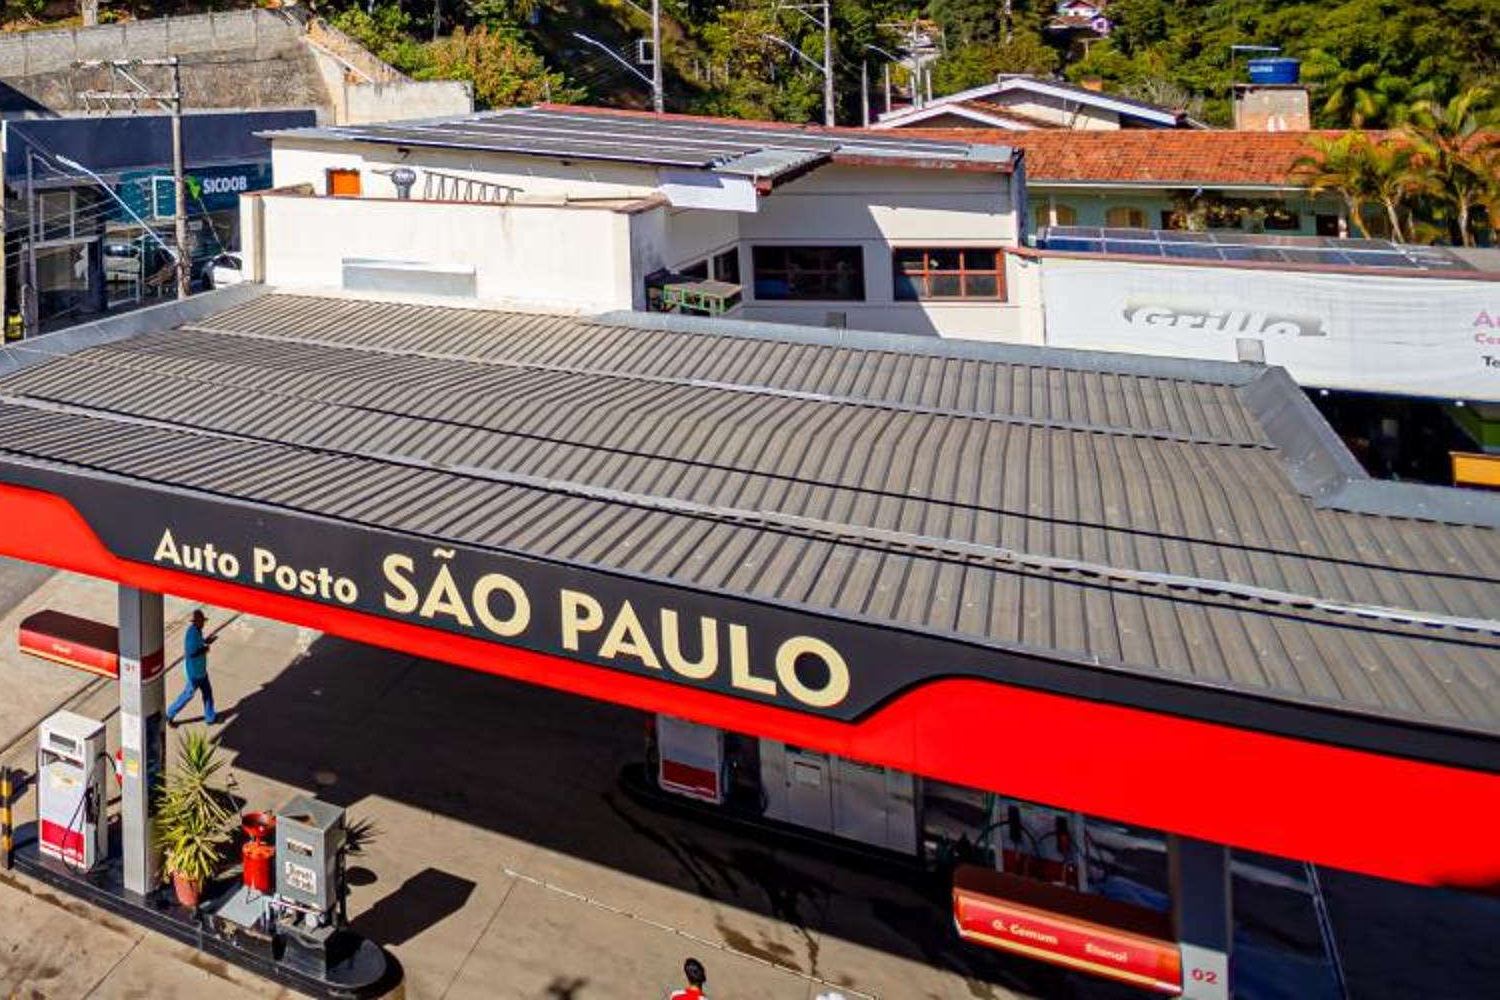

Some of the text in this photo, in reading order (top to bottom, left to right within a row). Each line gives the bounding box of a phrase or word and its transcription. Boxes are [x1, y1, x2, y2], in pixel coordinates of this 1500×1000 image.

[202, 176, 248, 194] SICOOB
[153, 528, 851, 708] Auto Posto SÃO PAULO
[1191, 967, 1218, 985] 02
